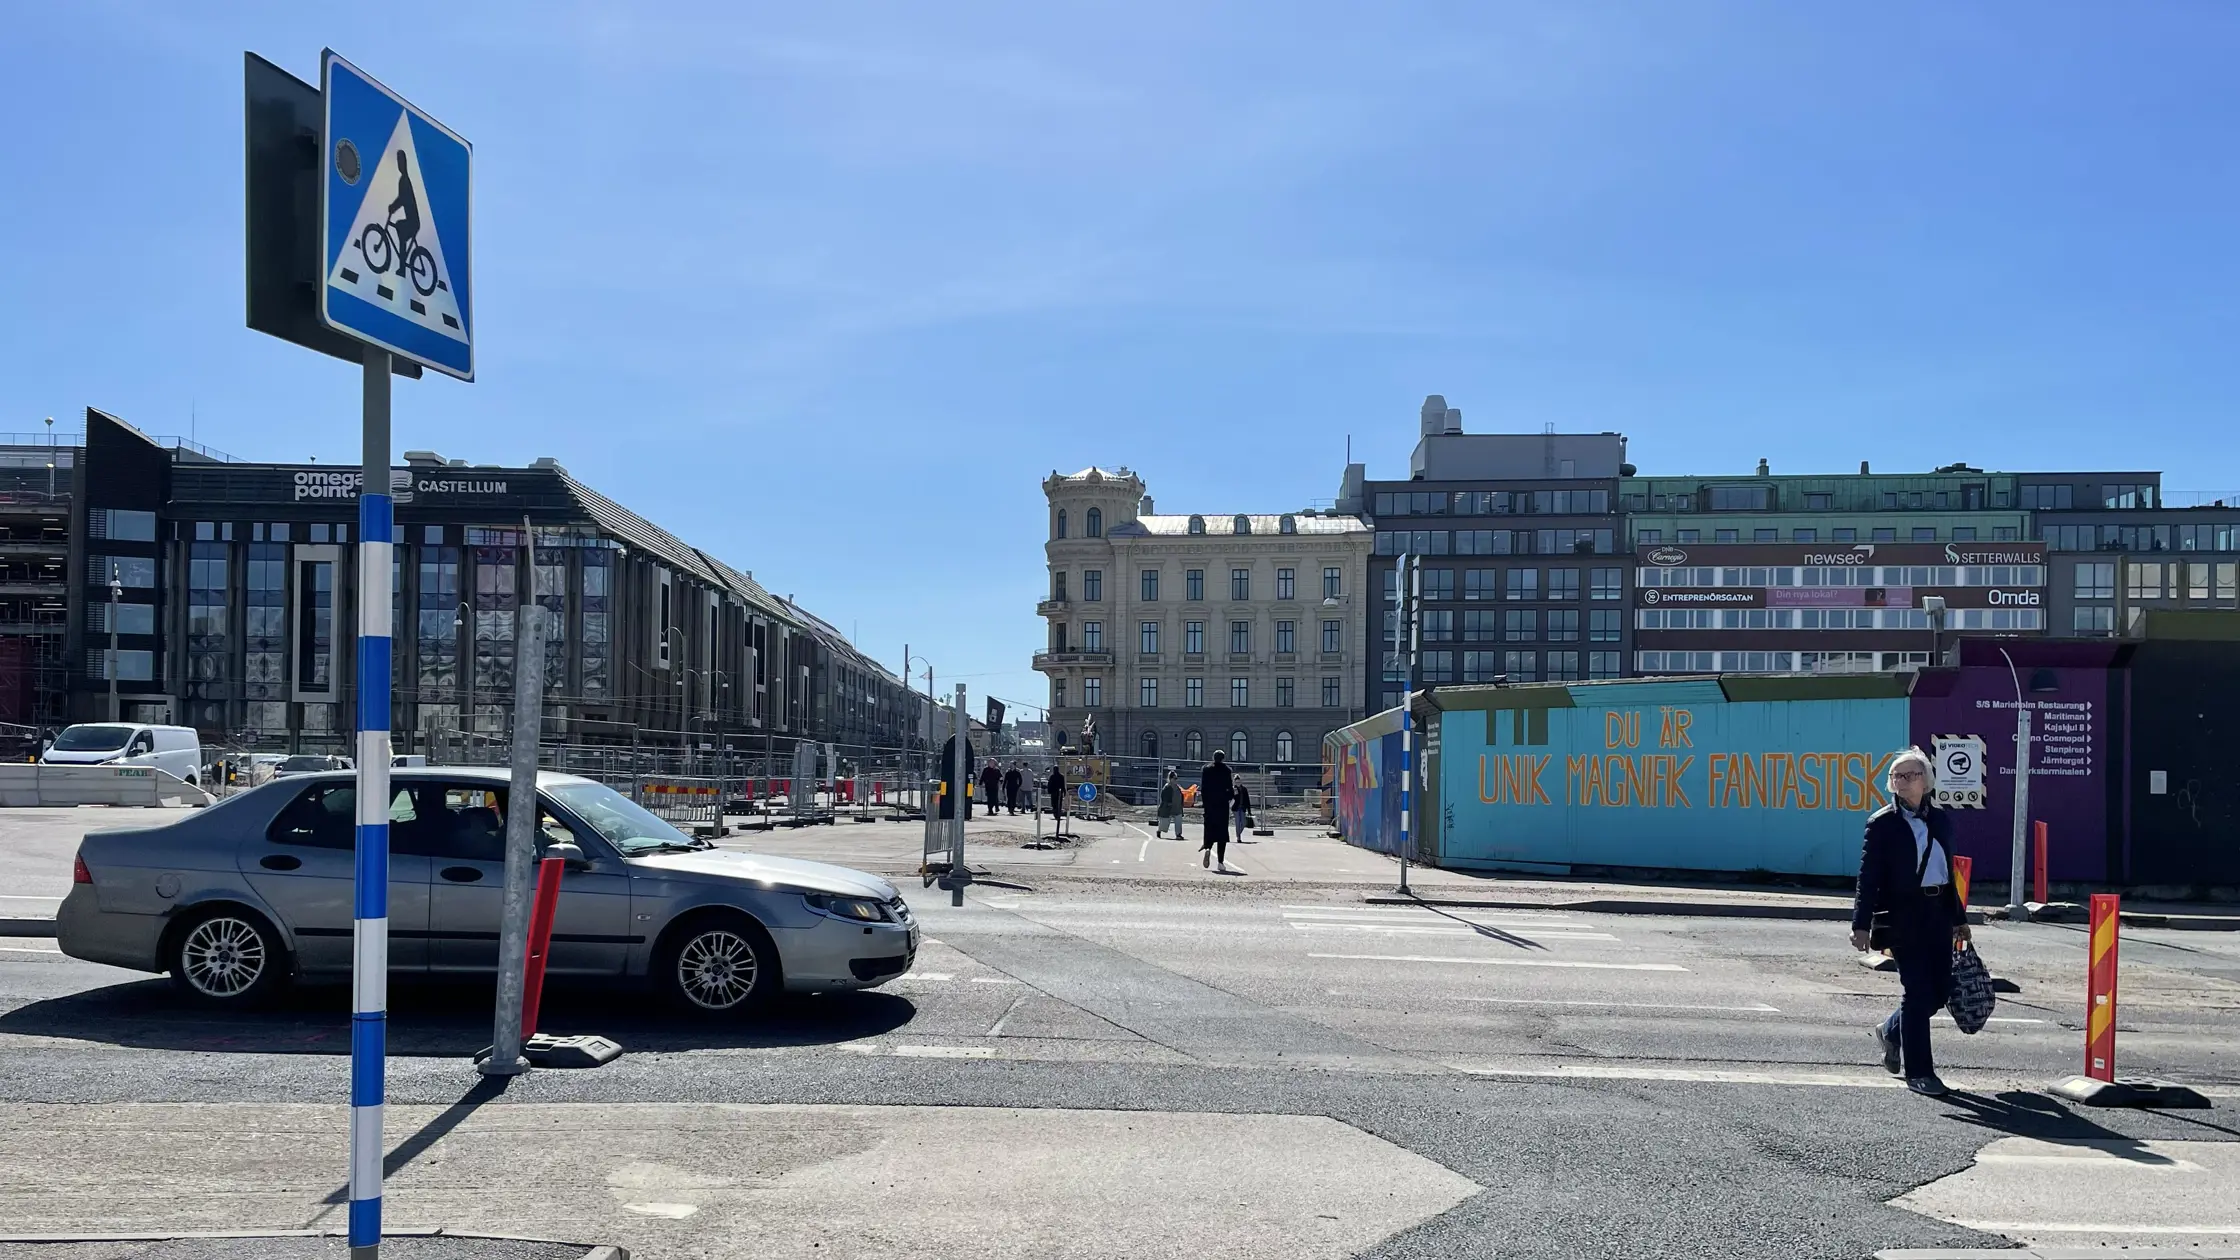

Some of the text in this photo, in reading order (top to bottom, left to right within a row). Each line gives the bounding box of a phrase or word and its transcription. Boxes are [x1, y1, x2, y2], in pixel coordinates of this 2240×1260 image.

[294, 472, 363, 491] omega
[418, 480, 507, 494] CASTELLUM
[295, 485, 357, 501] point.
[1652, 551, 1684, 563] Carnegie
[1804, 553, 1864, 565] newsec
[1961, 552, 2040, 564] SETTERWALLS
[1662, 592, 1753, 602] ENTREPRENÖRSGATAN
[1776, 590, 1838, 600] Din nya lokal?
[1988, 589, 2040, 605] Omda
[1976, 700, 2085, 711] S/S Marieholm Restaurang
[2044, 712, 2085, 721] Maritiman
[1605, 705, 1693, 749] DU ÄR
[2044, 723, 2085, 733] Kajskjul 8
[2012, 734, 2085, 744] Cno Cosmopol
[2045, 745, 2085, 754] Stenpiren
[2041, 756, 2085, 766] Järntorget
[2000, 766, 2085, 775] Danrksterminalen
[1478, 753, 1552, 805] UNIK
[1566, 753, 1694, 808] MAGNIFIK
[1709, 752, 1894, 811] FANTASTISK
